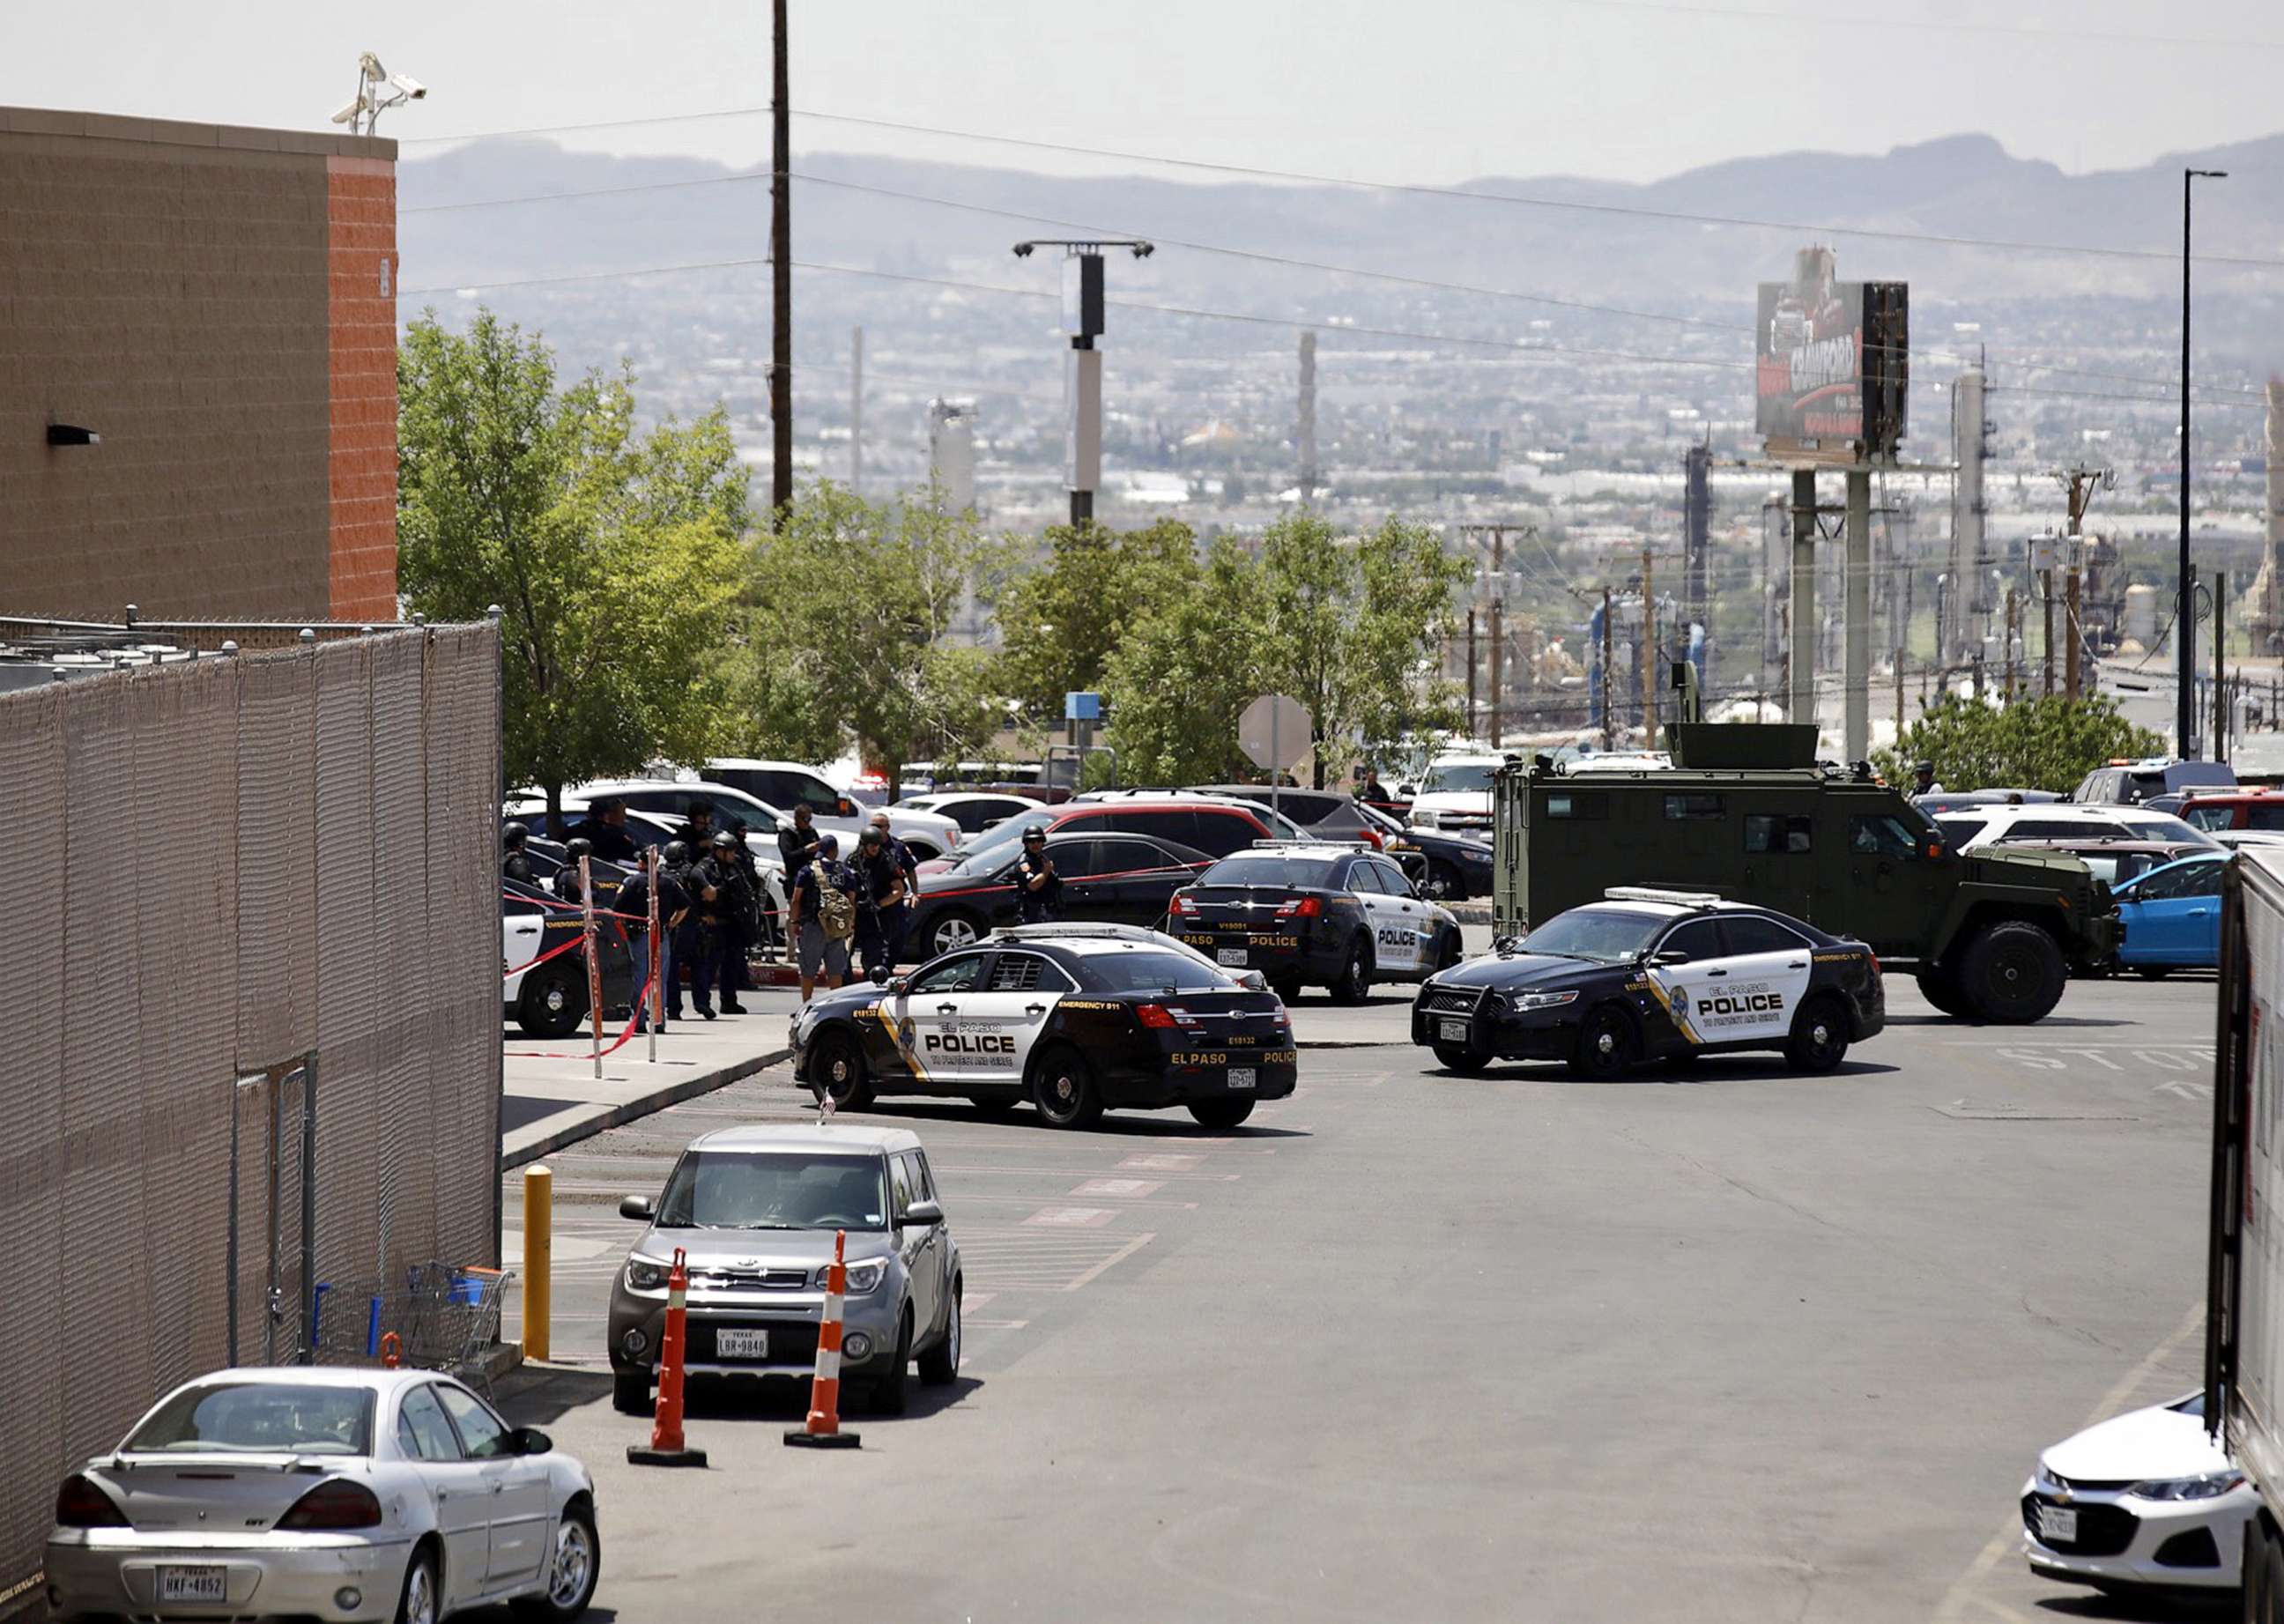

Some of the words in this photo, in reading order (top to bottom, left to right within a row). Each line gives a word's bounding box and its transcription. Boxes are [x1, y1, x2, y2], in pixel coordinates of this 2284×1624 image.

[1250, 937, 1297, 946] POLICE
[1379, 931, 1416, 945] POLICE
[1709, 986, 1727, 997] EL
[1729, 983, 1769, 995] PASO
[1058, 1001, 1105, 1010] EMERGENCY
[1697, 993, 1783, 1015] POLICE
[938, 1022, 957, 1033] EL
[959, 1022, 1001, 1033] PASO
[925, 1034, 1016, 1053] POLICE
[1171, 1054, 1187, 1064] EL
[1190, 1054, 1227, 1064] PASO
[1264, 1051, 1297, 1063] POLICE
